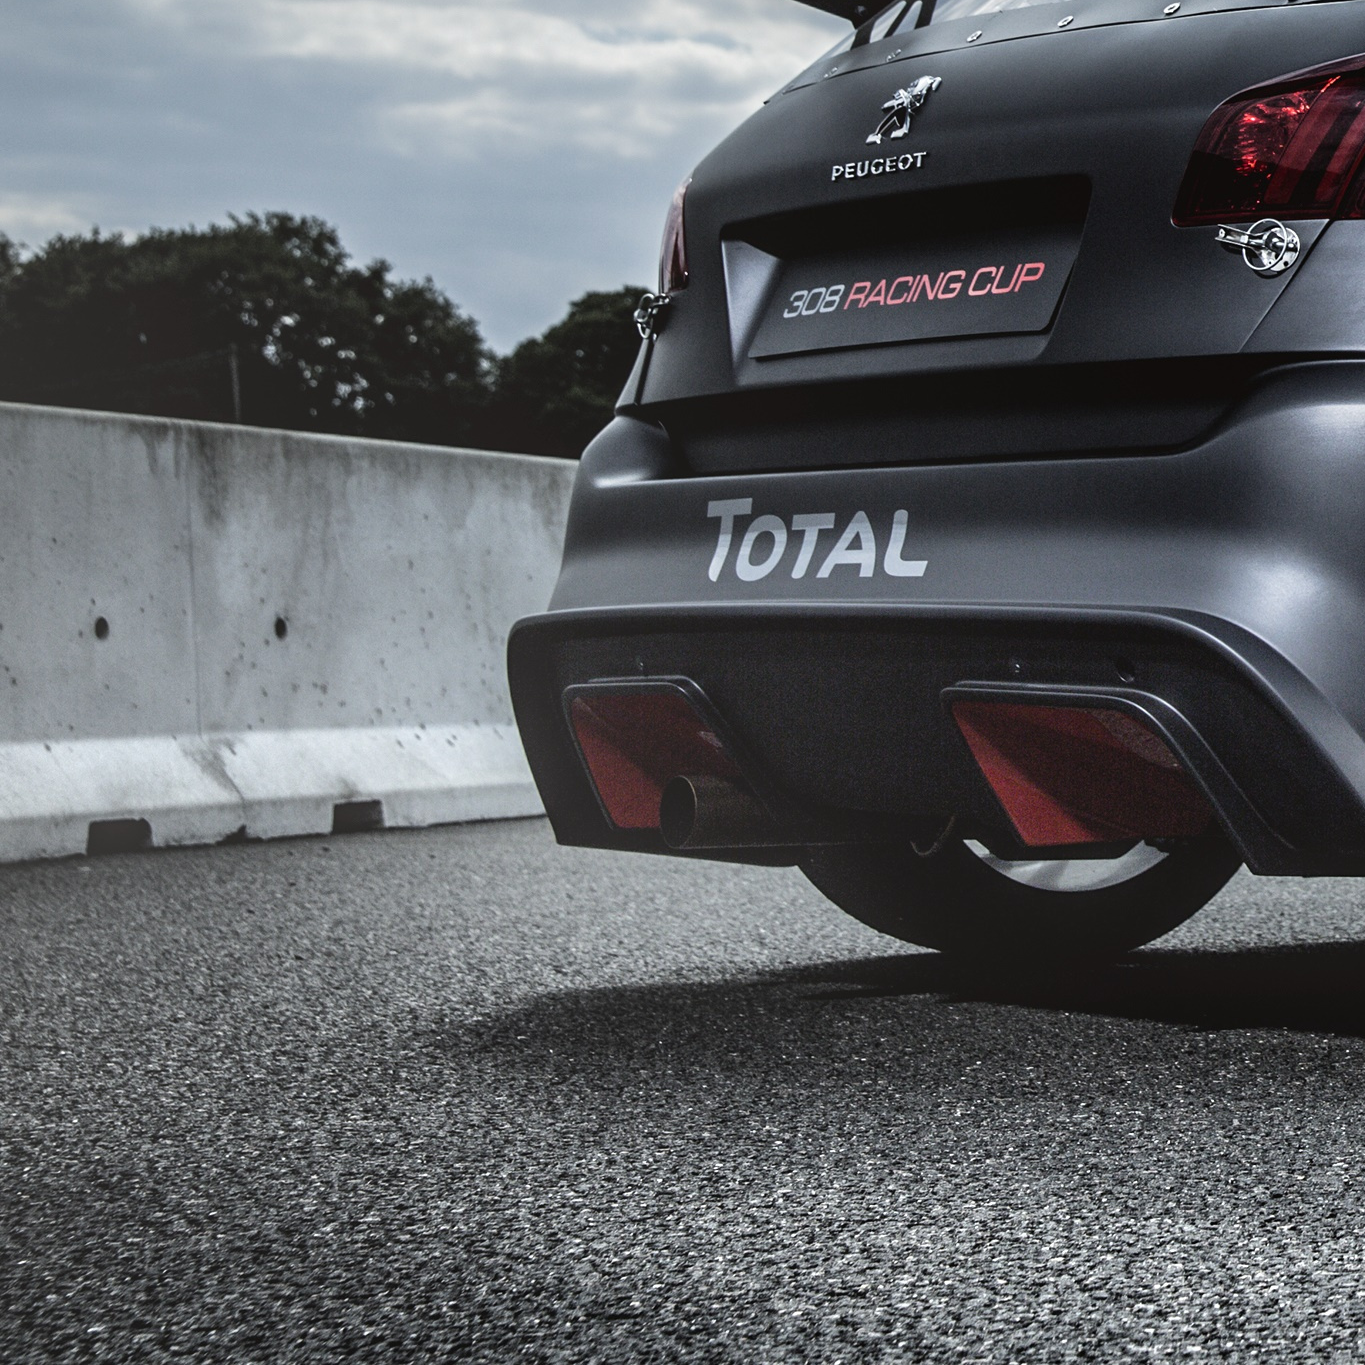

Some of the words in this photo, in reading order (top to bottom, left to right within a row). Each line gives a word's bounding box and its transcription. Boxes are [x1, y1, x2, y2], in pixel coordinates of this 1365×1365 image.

[831, 151, 927, 182] PEUGEOT
[783, 285, 843, 319] 308
[843, 269, 965, 310] RACING
[967, 262, 1045, 298] CUP
[706, 497, 929, 584] TOTAL
